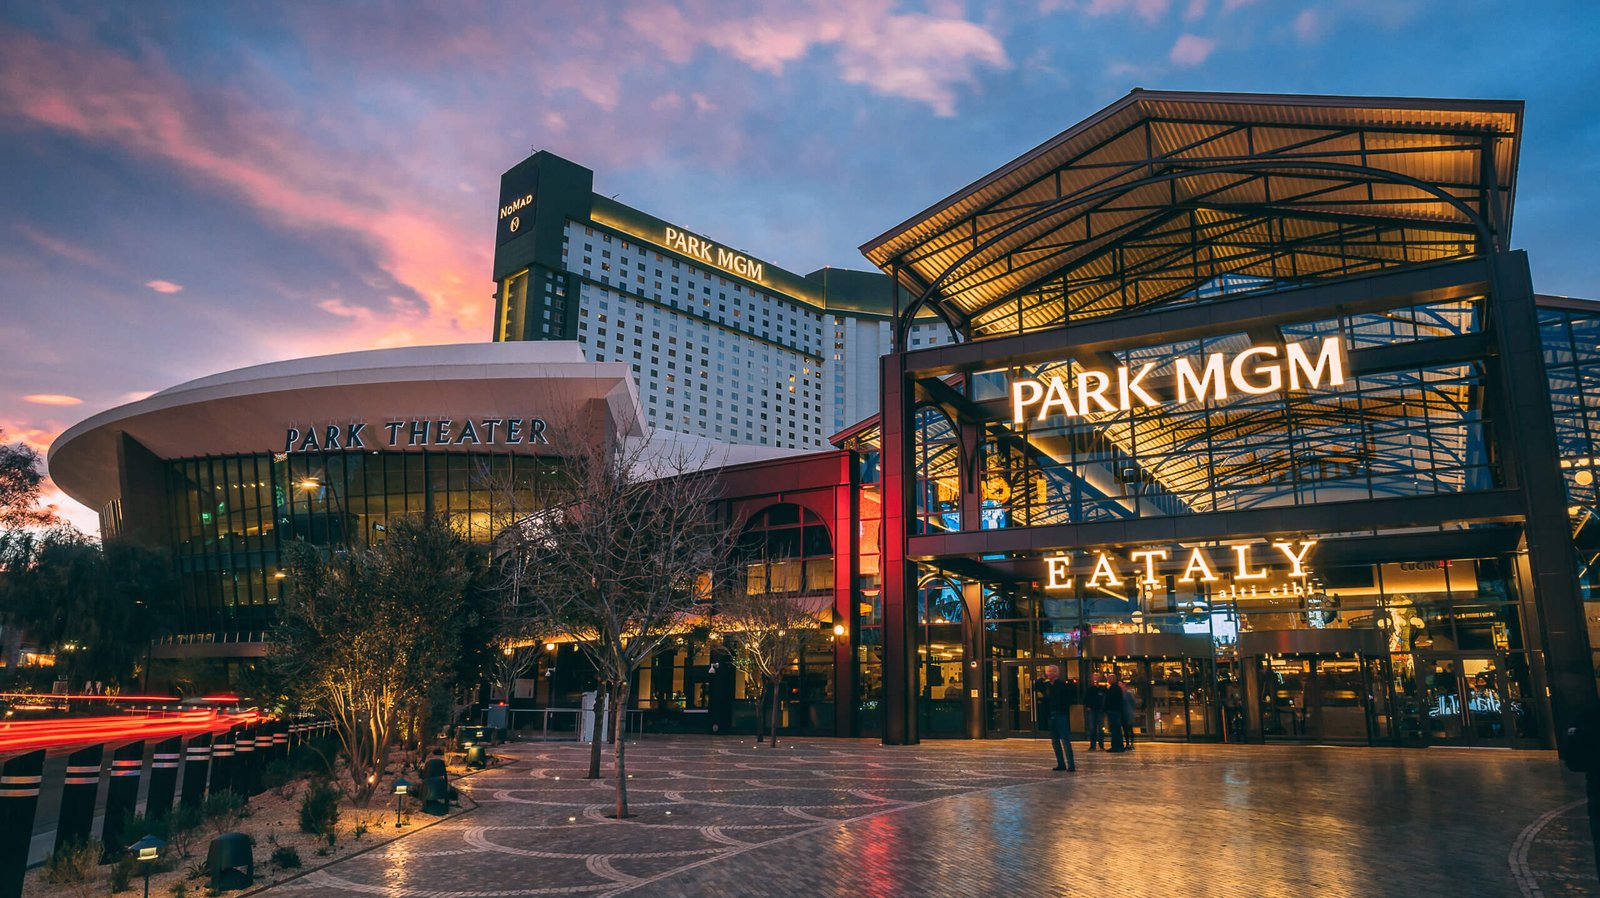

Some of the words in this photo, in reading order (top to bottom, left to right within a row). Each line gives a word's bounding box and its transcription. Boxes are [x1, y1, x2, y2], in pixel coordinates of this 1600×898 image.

[665, 227, 712, 262] PARK
[717, 247, 762, 281] MGM
[1012, 361, 1161, 424] PARK
[1175, 336, 1344, 404] MGM
[285, 423, 367, 453] PARK
[385, 418, 549, 447] THEATER
[1043, 540, 1317, 589] EATALY
[1218, 585, 1257, 599] alti
[1269, 582, 1315, 597] cibi
